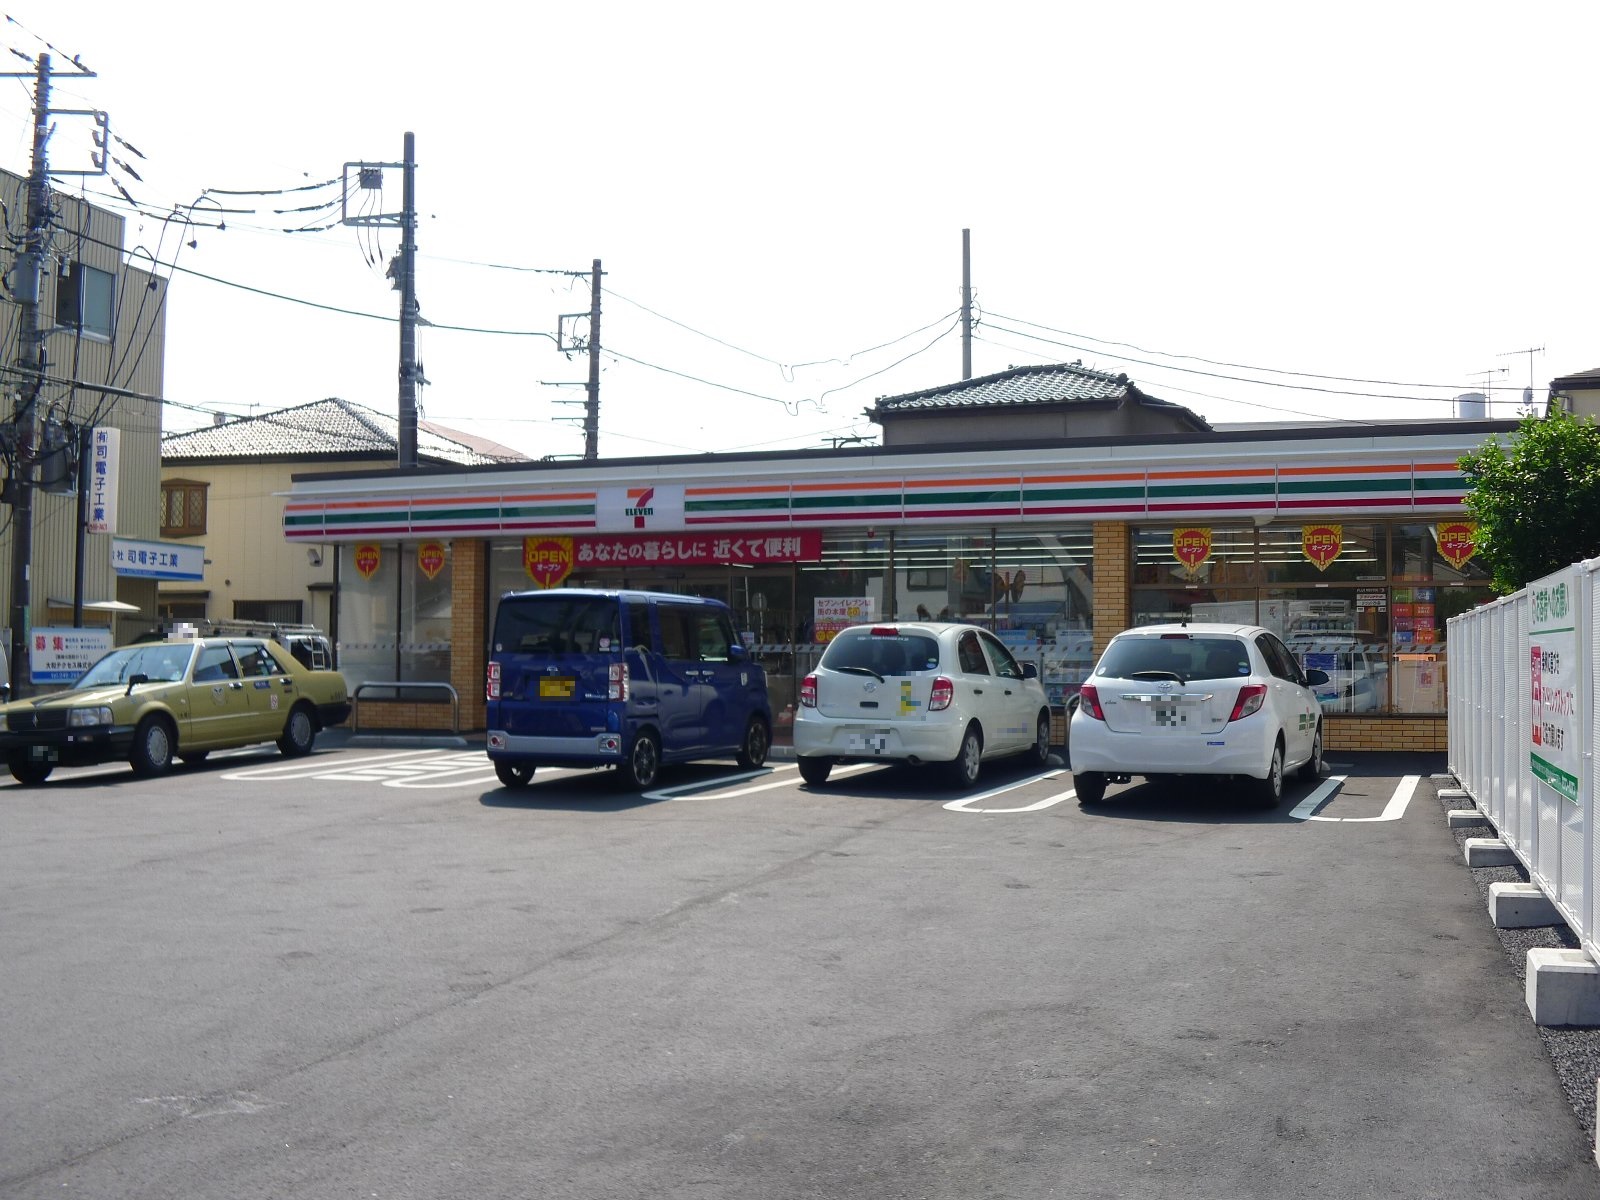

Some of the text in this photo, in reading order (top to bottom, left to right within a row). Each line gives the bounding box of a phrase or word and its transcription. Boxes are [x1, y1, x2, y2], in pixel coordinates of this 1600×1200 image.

[1175, 537, 1209, 546] OPEN
[1305, 535, 1341, 544] OPEN
[420, 549, 442, 558] OPEN
[578, 537, 801, 562] あなたの暮らしに 近くて便利
[127, 549, 178, 567] 司電子工業
[356, 551, 379, 559] OPEN
[529, 550, 569, 562] OPEN
